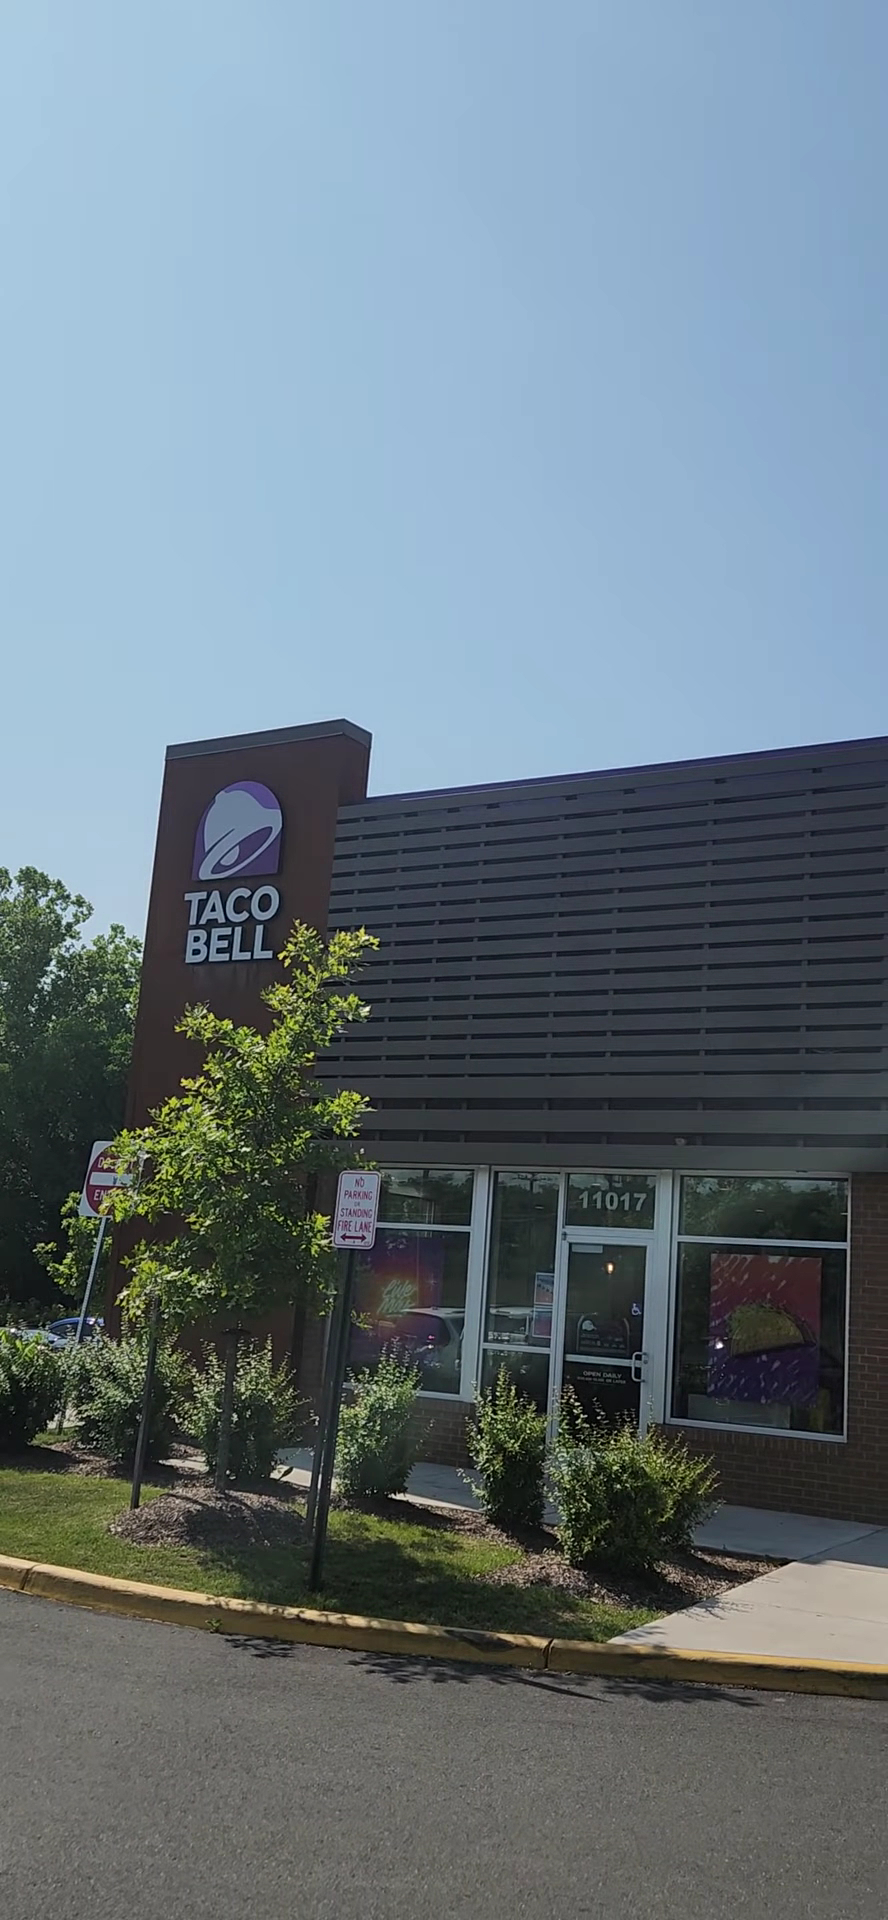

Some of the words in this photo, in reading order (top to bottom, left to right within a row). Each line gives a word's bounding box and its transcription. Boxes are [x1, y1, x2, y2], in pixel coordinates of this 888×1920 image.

[184, 885, 280, 926] TACO
[184, 924, 274, 964] BELL
[354, 1178, 365, 1188] NO
[343, 1190, 373, 1200] PARKING
[578, 1190, 648, 1211] 11017
[340, 1208, 373, 1219] STANDING
[337, 1220, 352, 1232] FIRE
[354, 1221, 372, 1233] LANE
